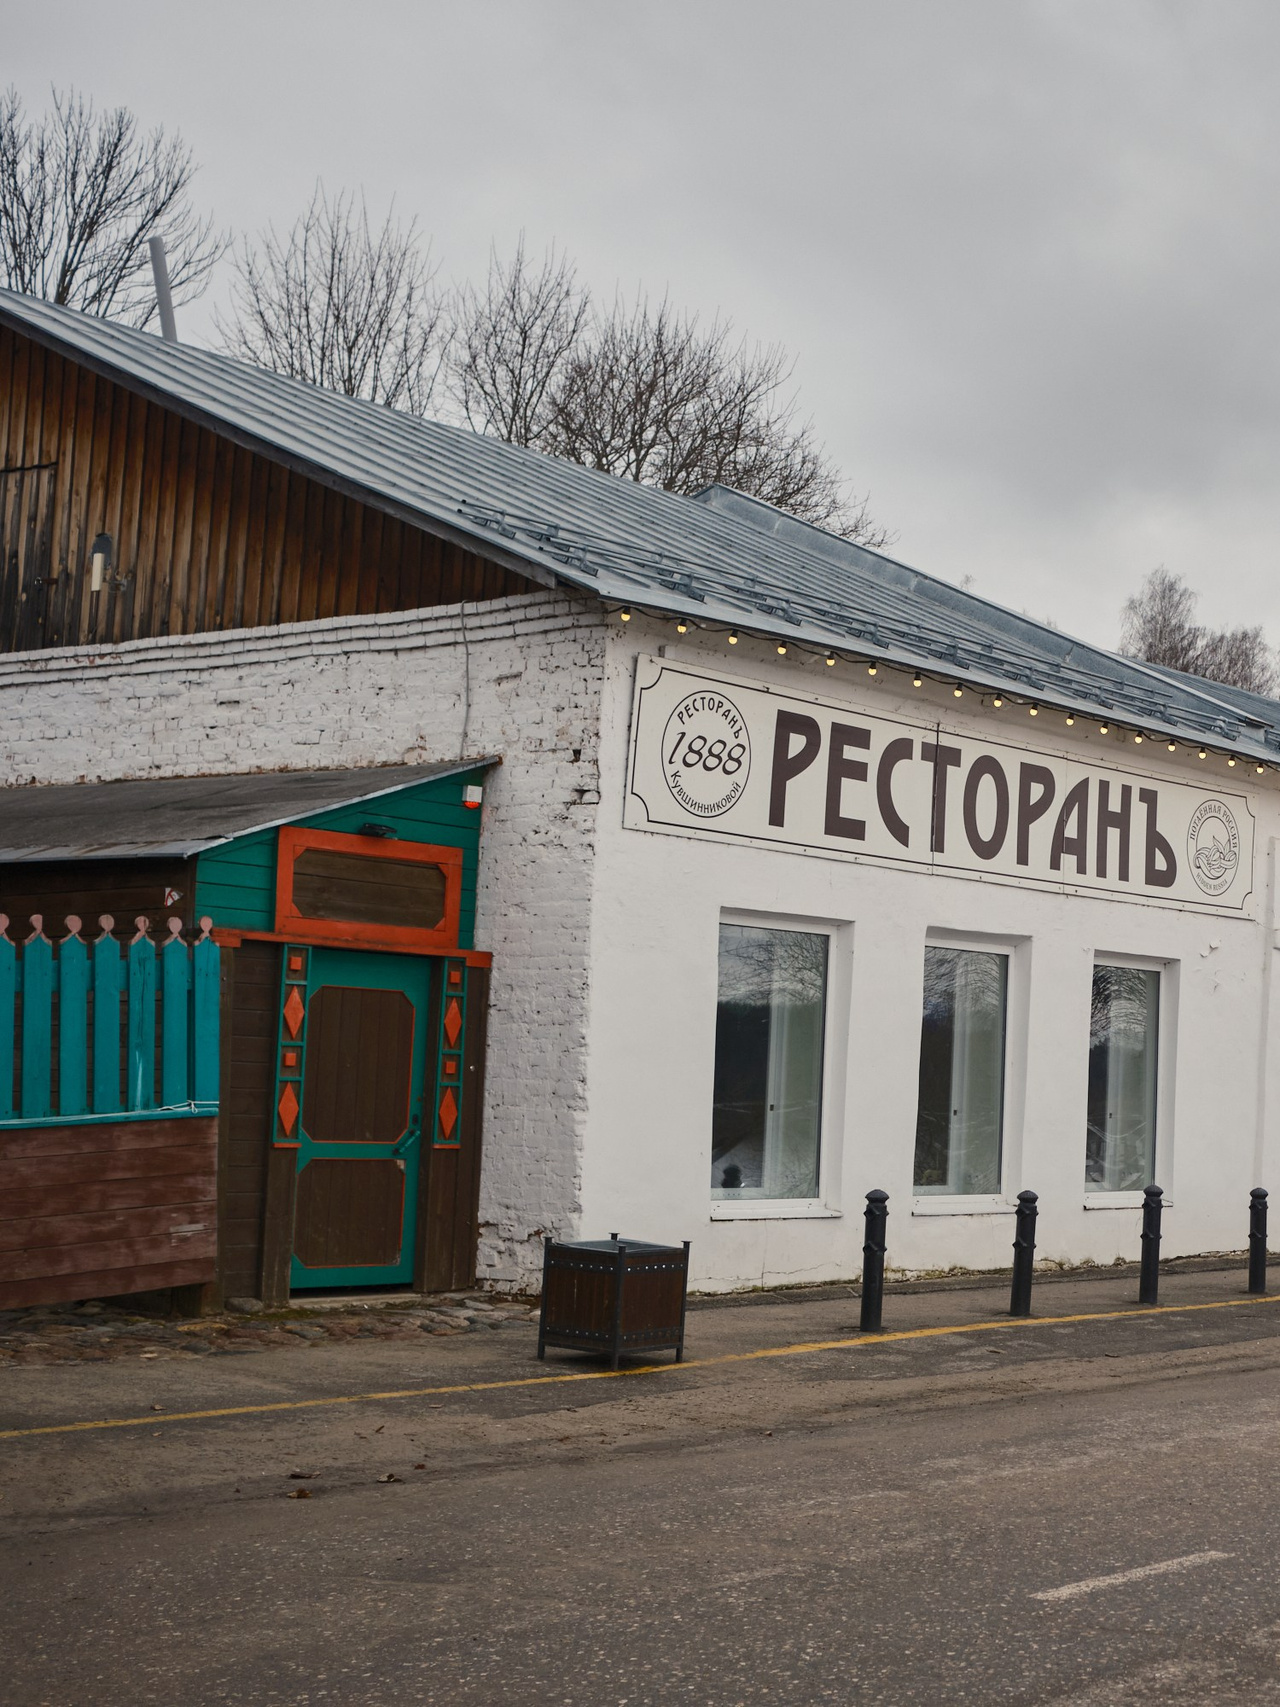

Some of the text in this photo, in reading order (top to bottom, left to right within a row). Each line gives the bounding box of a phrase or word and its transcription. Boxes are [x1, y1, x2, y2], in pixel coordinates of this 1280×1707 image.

[677, 697, 742, 739] РЕСТОРАНЪ
[668, 732, 746, 775] 1888
[671, 771, 741, 813] Кувшинниковой
[769, 709, 1178, 888] РЕСТОРАНЪ
[1222, 810, 1237, 848] РОССИЯ
